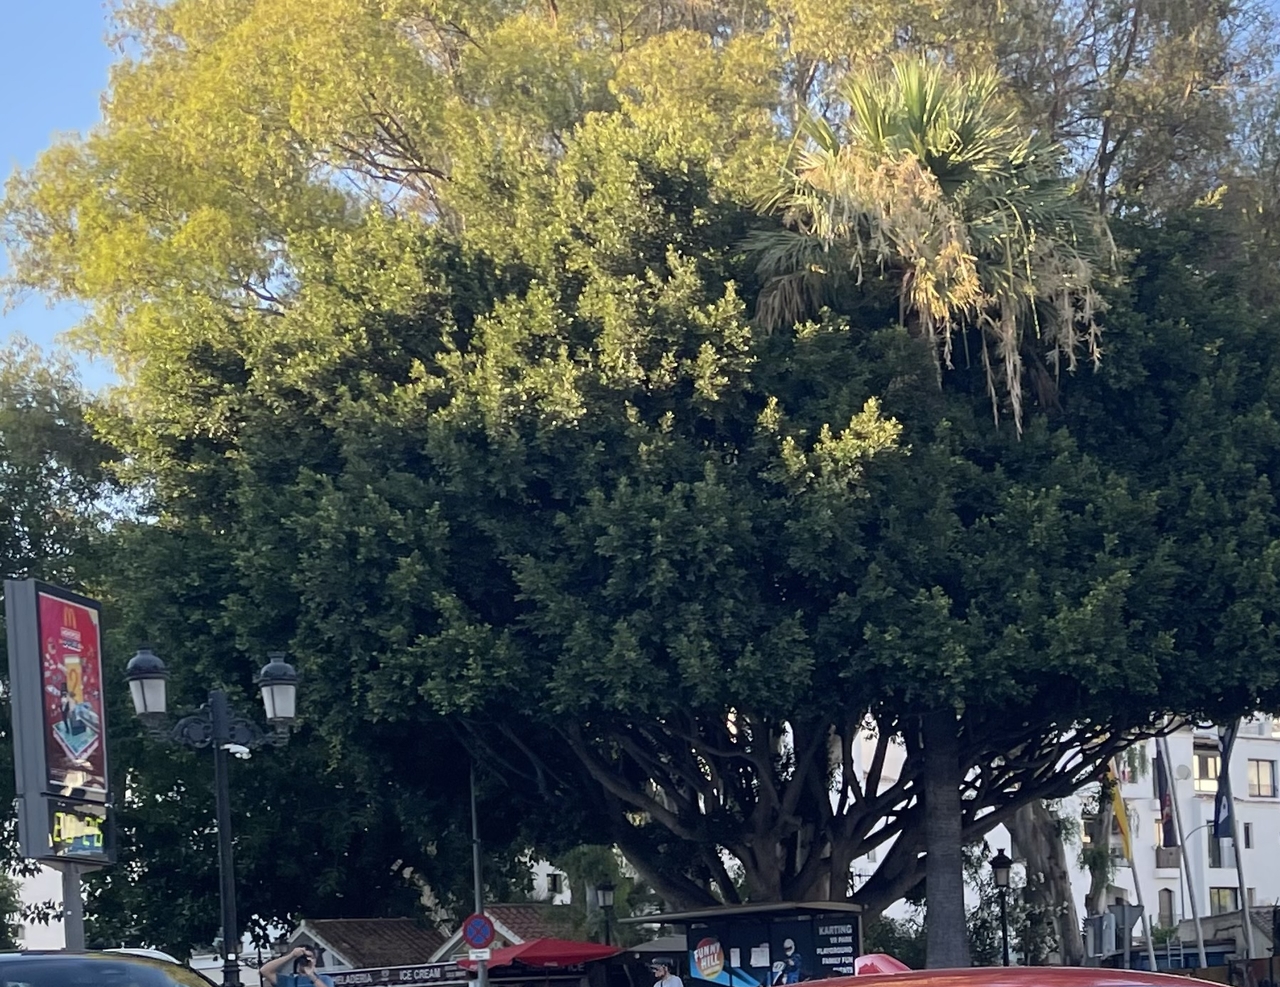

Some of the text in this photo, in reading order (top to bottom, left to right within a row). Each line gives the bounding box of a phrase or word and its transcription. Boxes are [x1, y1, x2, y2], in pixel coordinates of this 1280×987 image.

[819, 925, 852, 935] KARTING
[694, 942, 720, 962] FUNNY
[701, 954, 720, 970] HILL
[400, 970, 413, 981] ICE
[414, 968, 441, 980] CREAM
